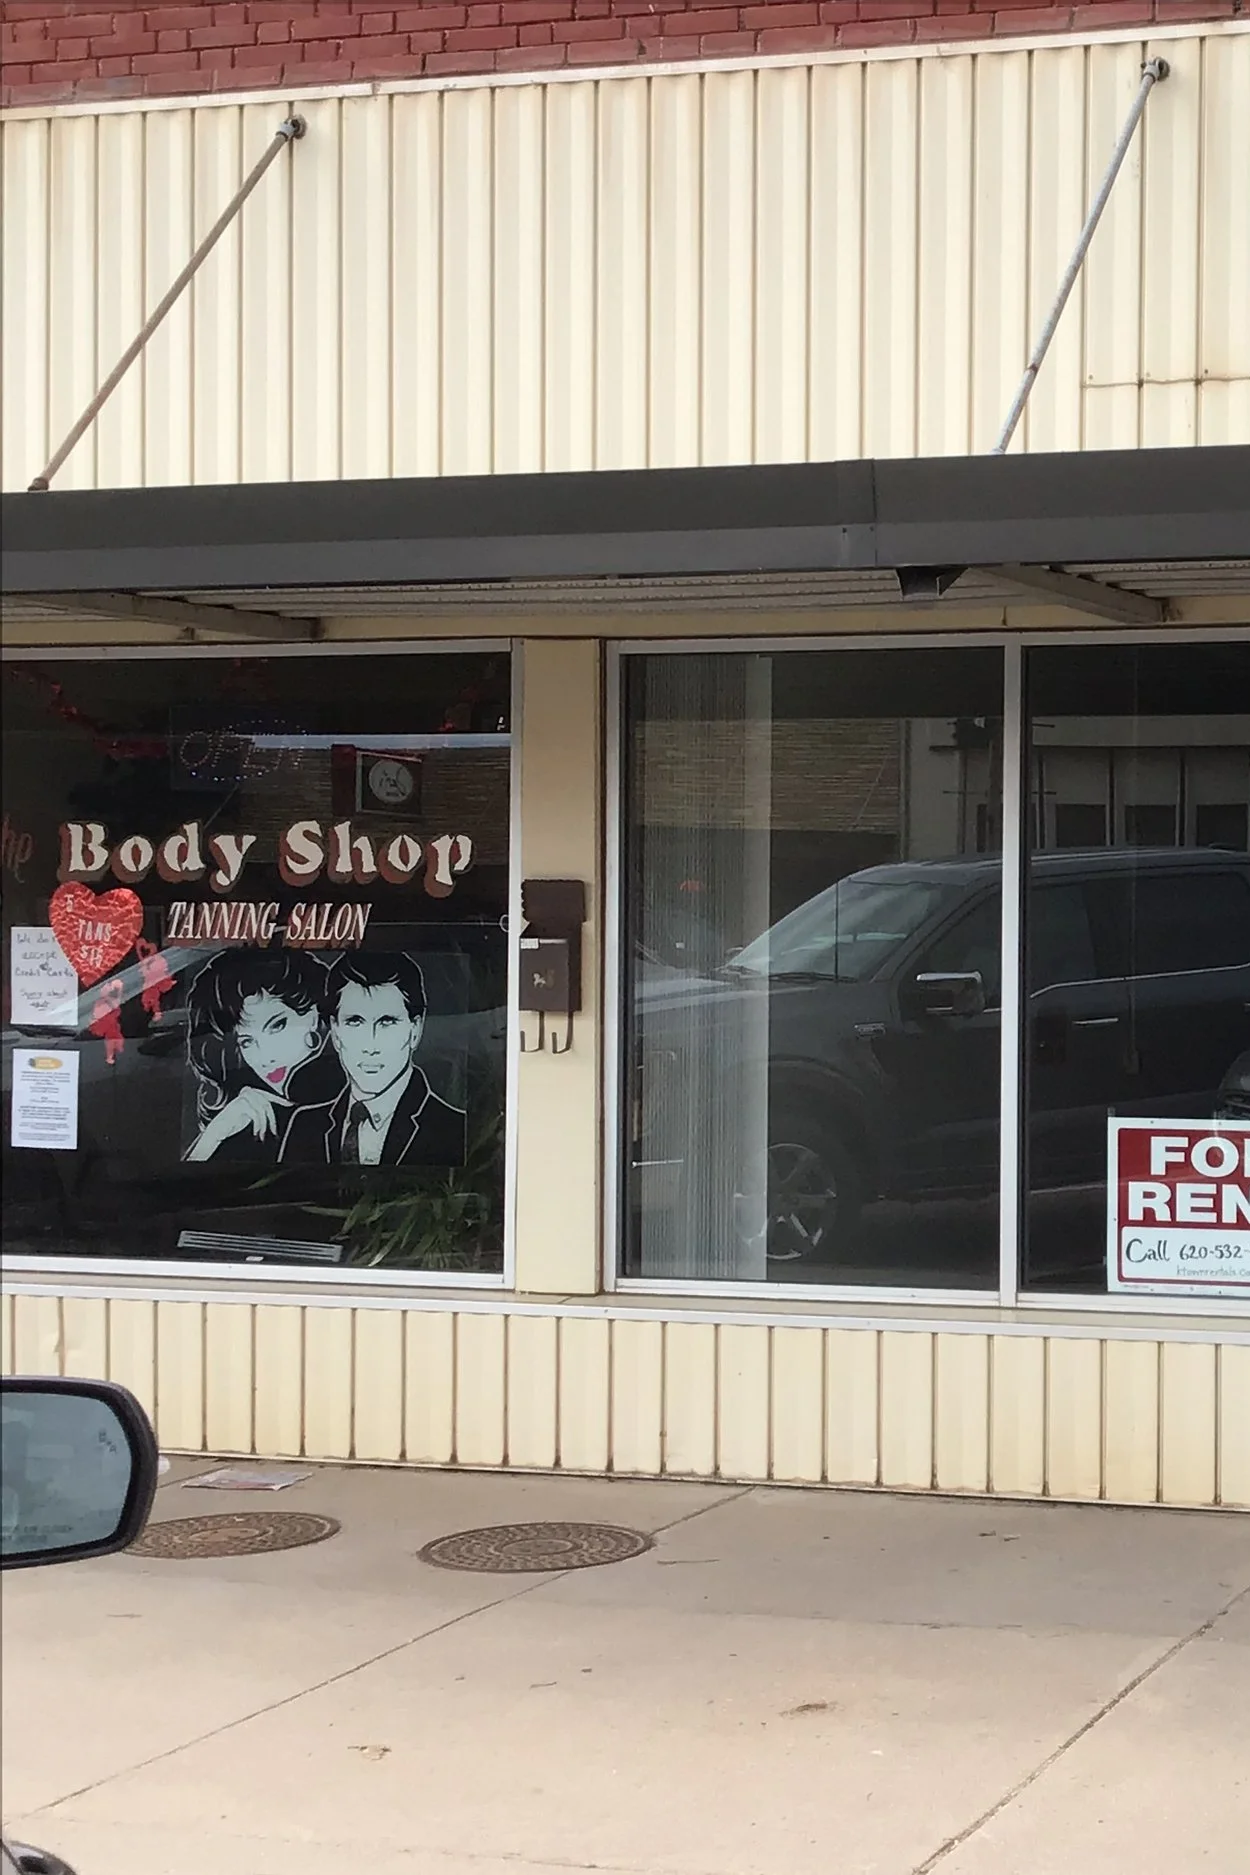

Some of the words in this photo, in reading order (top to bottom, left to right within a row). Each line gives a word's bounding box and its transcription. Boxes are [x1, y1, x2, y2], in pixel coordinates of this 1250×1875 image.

[60, 821, 257, 890] Body
[281, 819, 474, 893] Shop
[167, 901, 280, 943] TANNING
[285, 902, 373, 945] SALON
[1125, 1238, 1170, 1263] Call
